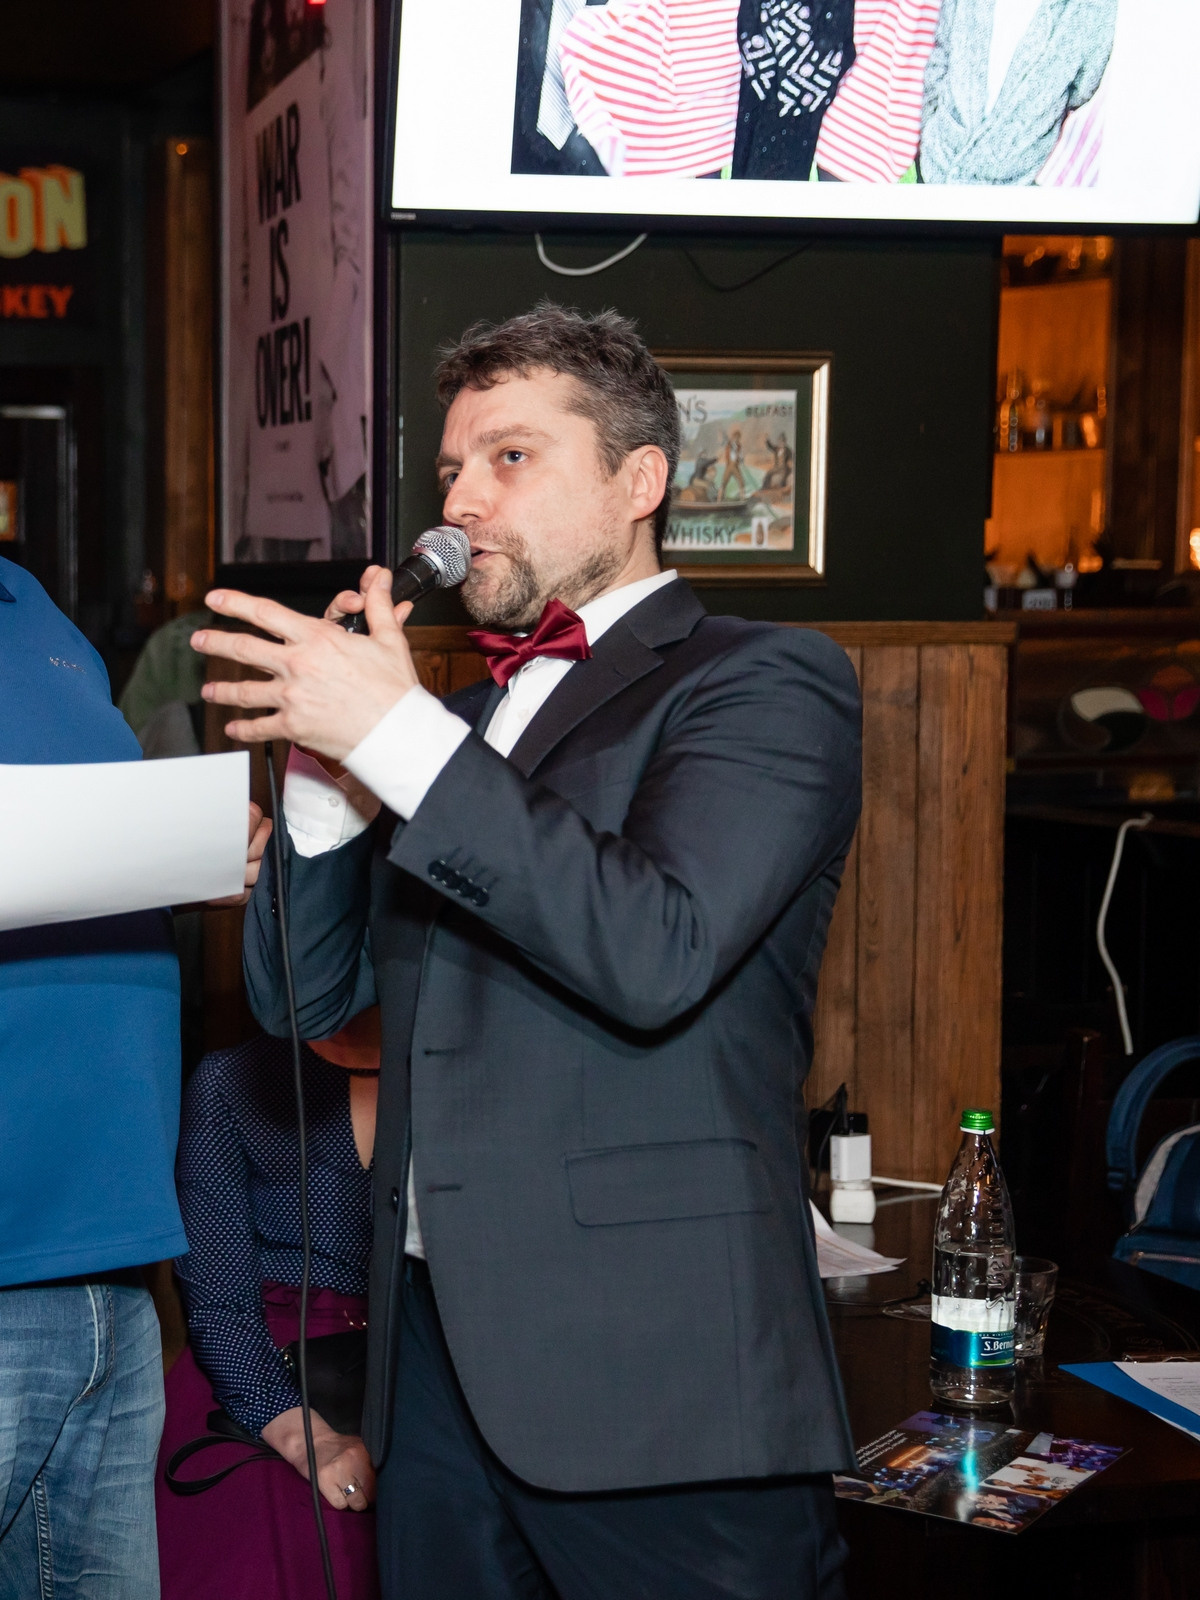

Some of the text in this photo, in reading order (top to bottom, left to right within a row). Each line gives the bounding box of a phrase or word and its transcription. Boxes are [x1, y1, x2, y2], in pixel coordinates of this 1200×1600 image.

[256, 102, 301, 225] WAR
[269, 218, 290, 324] IS
[255, 317, 312, 429] OVER!
[677, 394, 708, 424] N'S
[664, 521, 737, 546] WHISKY
